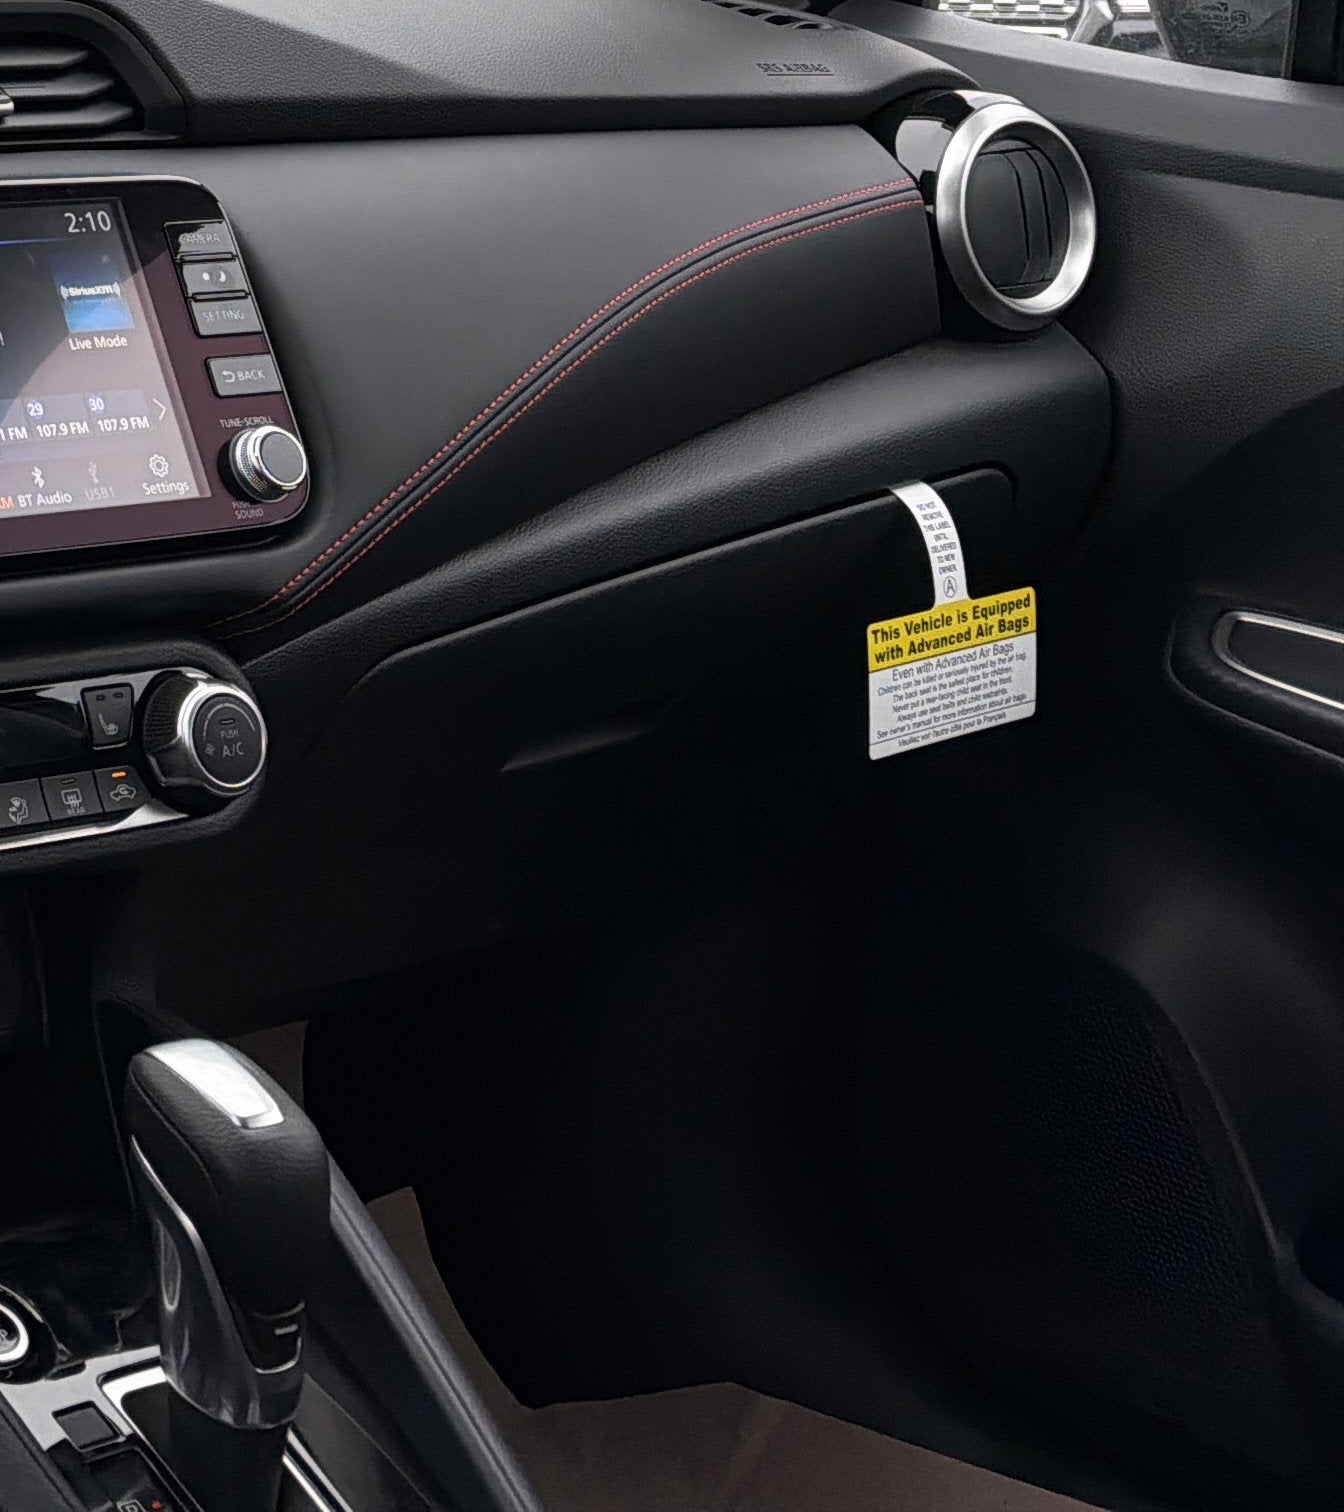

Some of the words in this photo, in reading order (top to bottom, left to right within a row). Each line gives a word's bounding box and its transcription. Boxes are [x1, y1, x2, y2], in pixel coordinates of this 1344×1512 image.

[64, 210, 111, 234] 2:10
[202, 309, 246, 322] SETTING
[68, 337, 93, 351] Live
[95, 335, 129, 348] Mode
[235, 369, 266, 381] BACK
[27, 402, 44, 417] 29
[88, 397, 105, 412] 30
[36, 423, 69, 438] 107.9
[70, 421, 90, 435] FM
[97, 418, 129, 433] 107.9
[130, 416, 150, 430] FM
[8, 426, 28, 441] FM
[85, 487, 115, 501] USB1
[142, 481, 190, 496] Settings
[17, 494, 33, 508] BT
[36, 491, 73, 506] Audio
[235, 508, 264, 520] SOUND
[871, 628, 900, 644] This
[904, 613, 952, 636] Vehicle
[957, 610, 968, 624] is
[972, 593, 1031, 620] Equipped
[874, 645, 903, 664] with
[907, 629, 971, 656] Advanced
[976, 623, 994, 639] Air
[998, 615, 1030, 633] Bags
[892, 666, 913, 681] Even
[916, 660, 933, 675] with
[935, 649, 976, 670] Advanced
[979, 646, 989, 659] Air
[992, 640, 1013, 658] Bags
[222, 741, 244, 758] A/C
